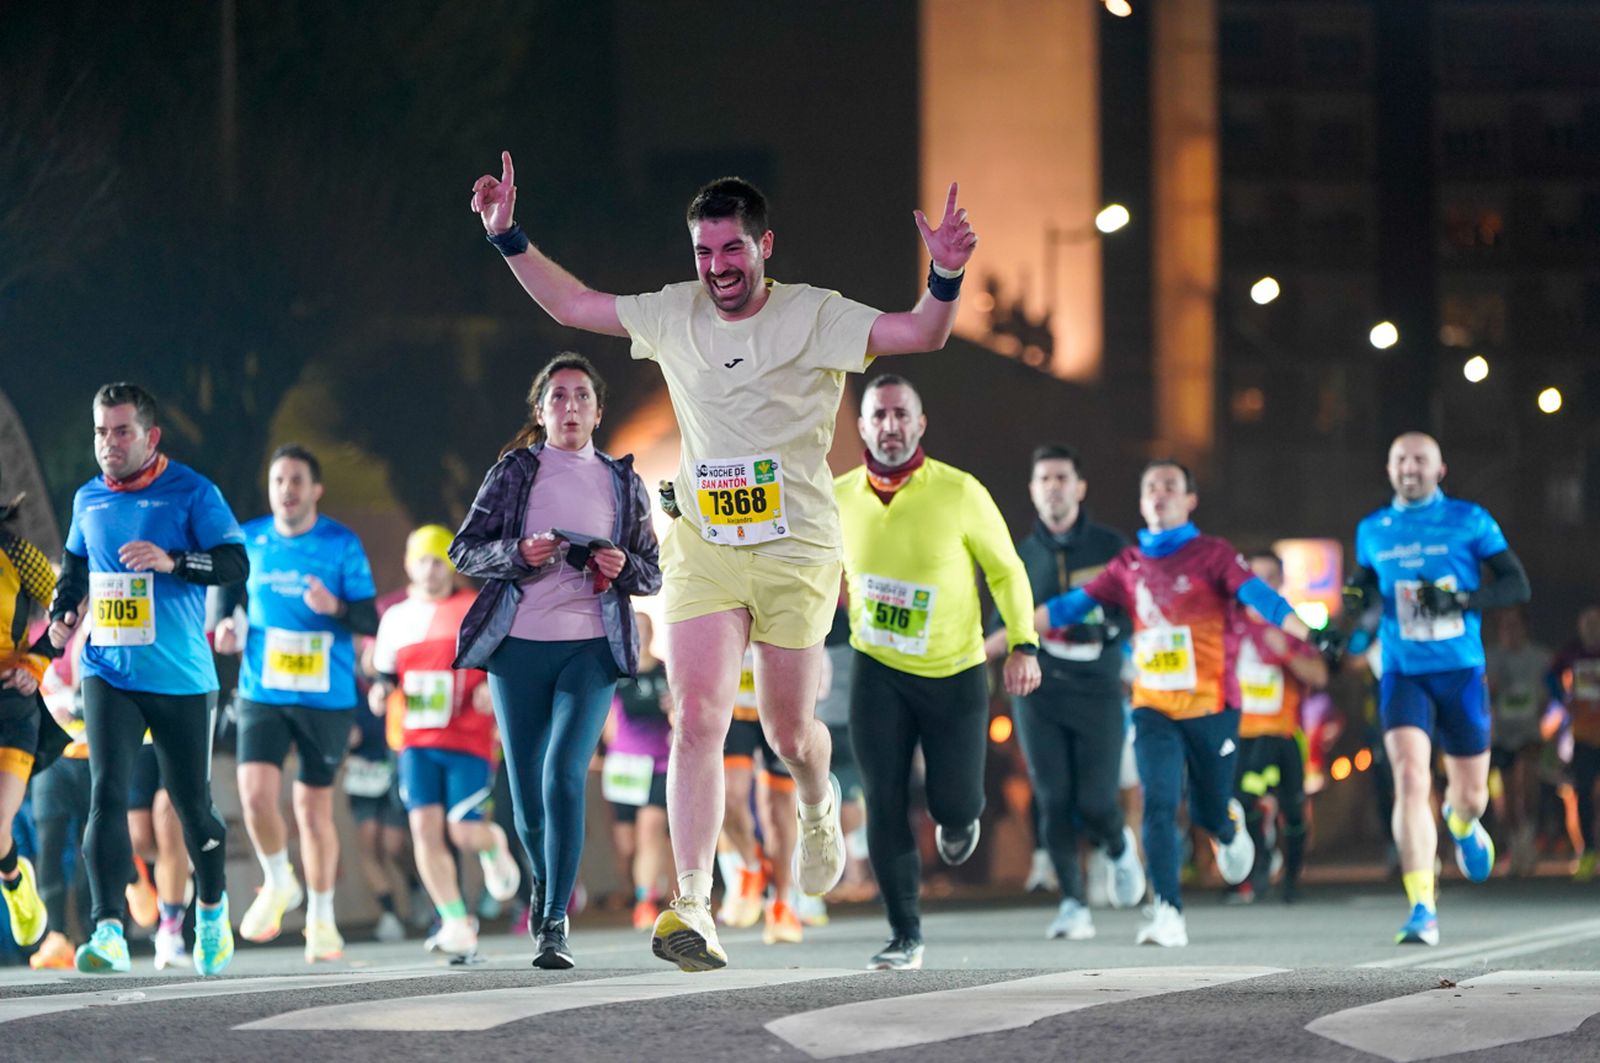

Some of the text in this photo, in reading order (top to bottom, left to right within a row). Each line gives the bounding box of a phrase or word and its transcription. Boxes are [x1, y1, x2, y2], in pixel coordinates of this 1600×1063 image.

[709, 467, 733, 478] NOCHE
[734, 466, 746, 476] DE
[701, 479, 716, 489] SAN
[708, 487, 767, 516] 7368
[98, 599, 138, 621] 6705
[876, 601, 911, 629] 576
